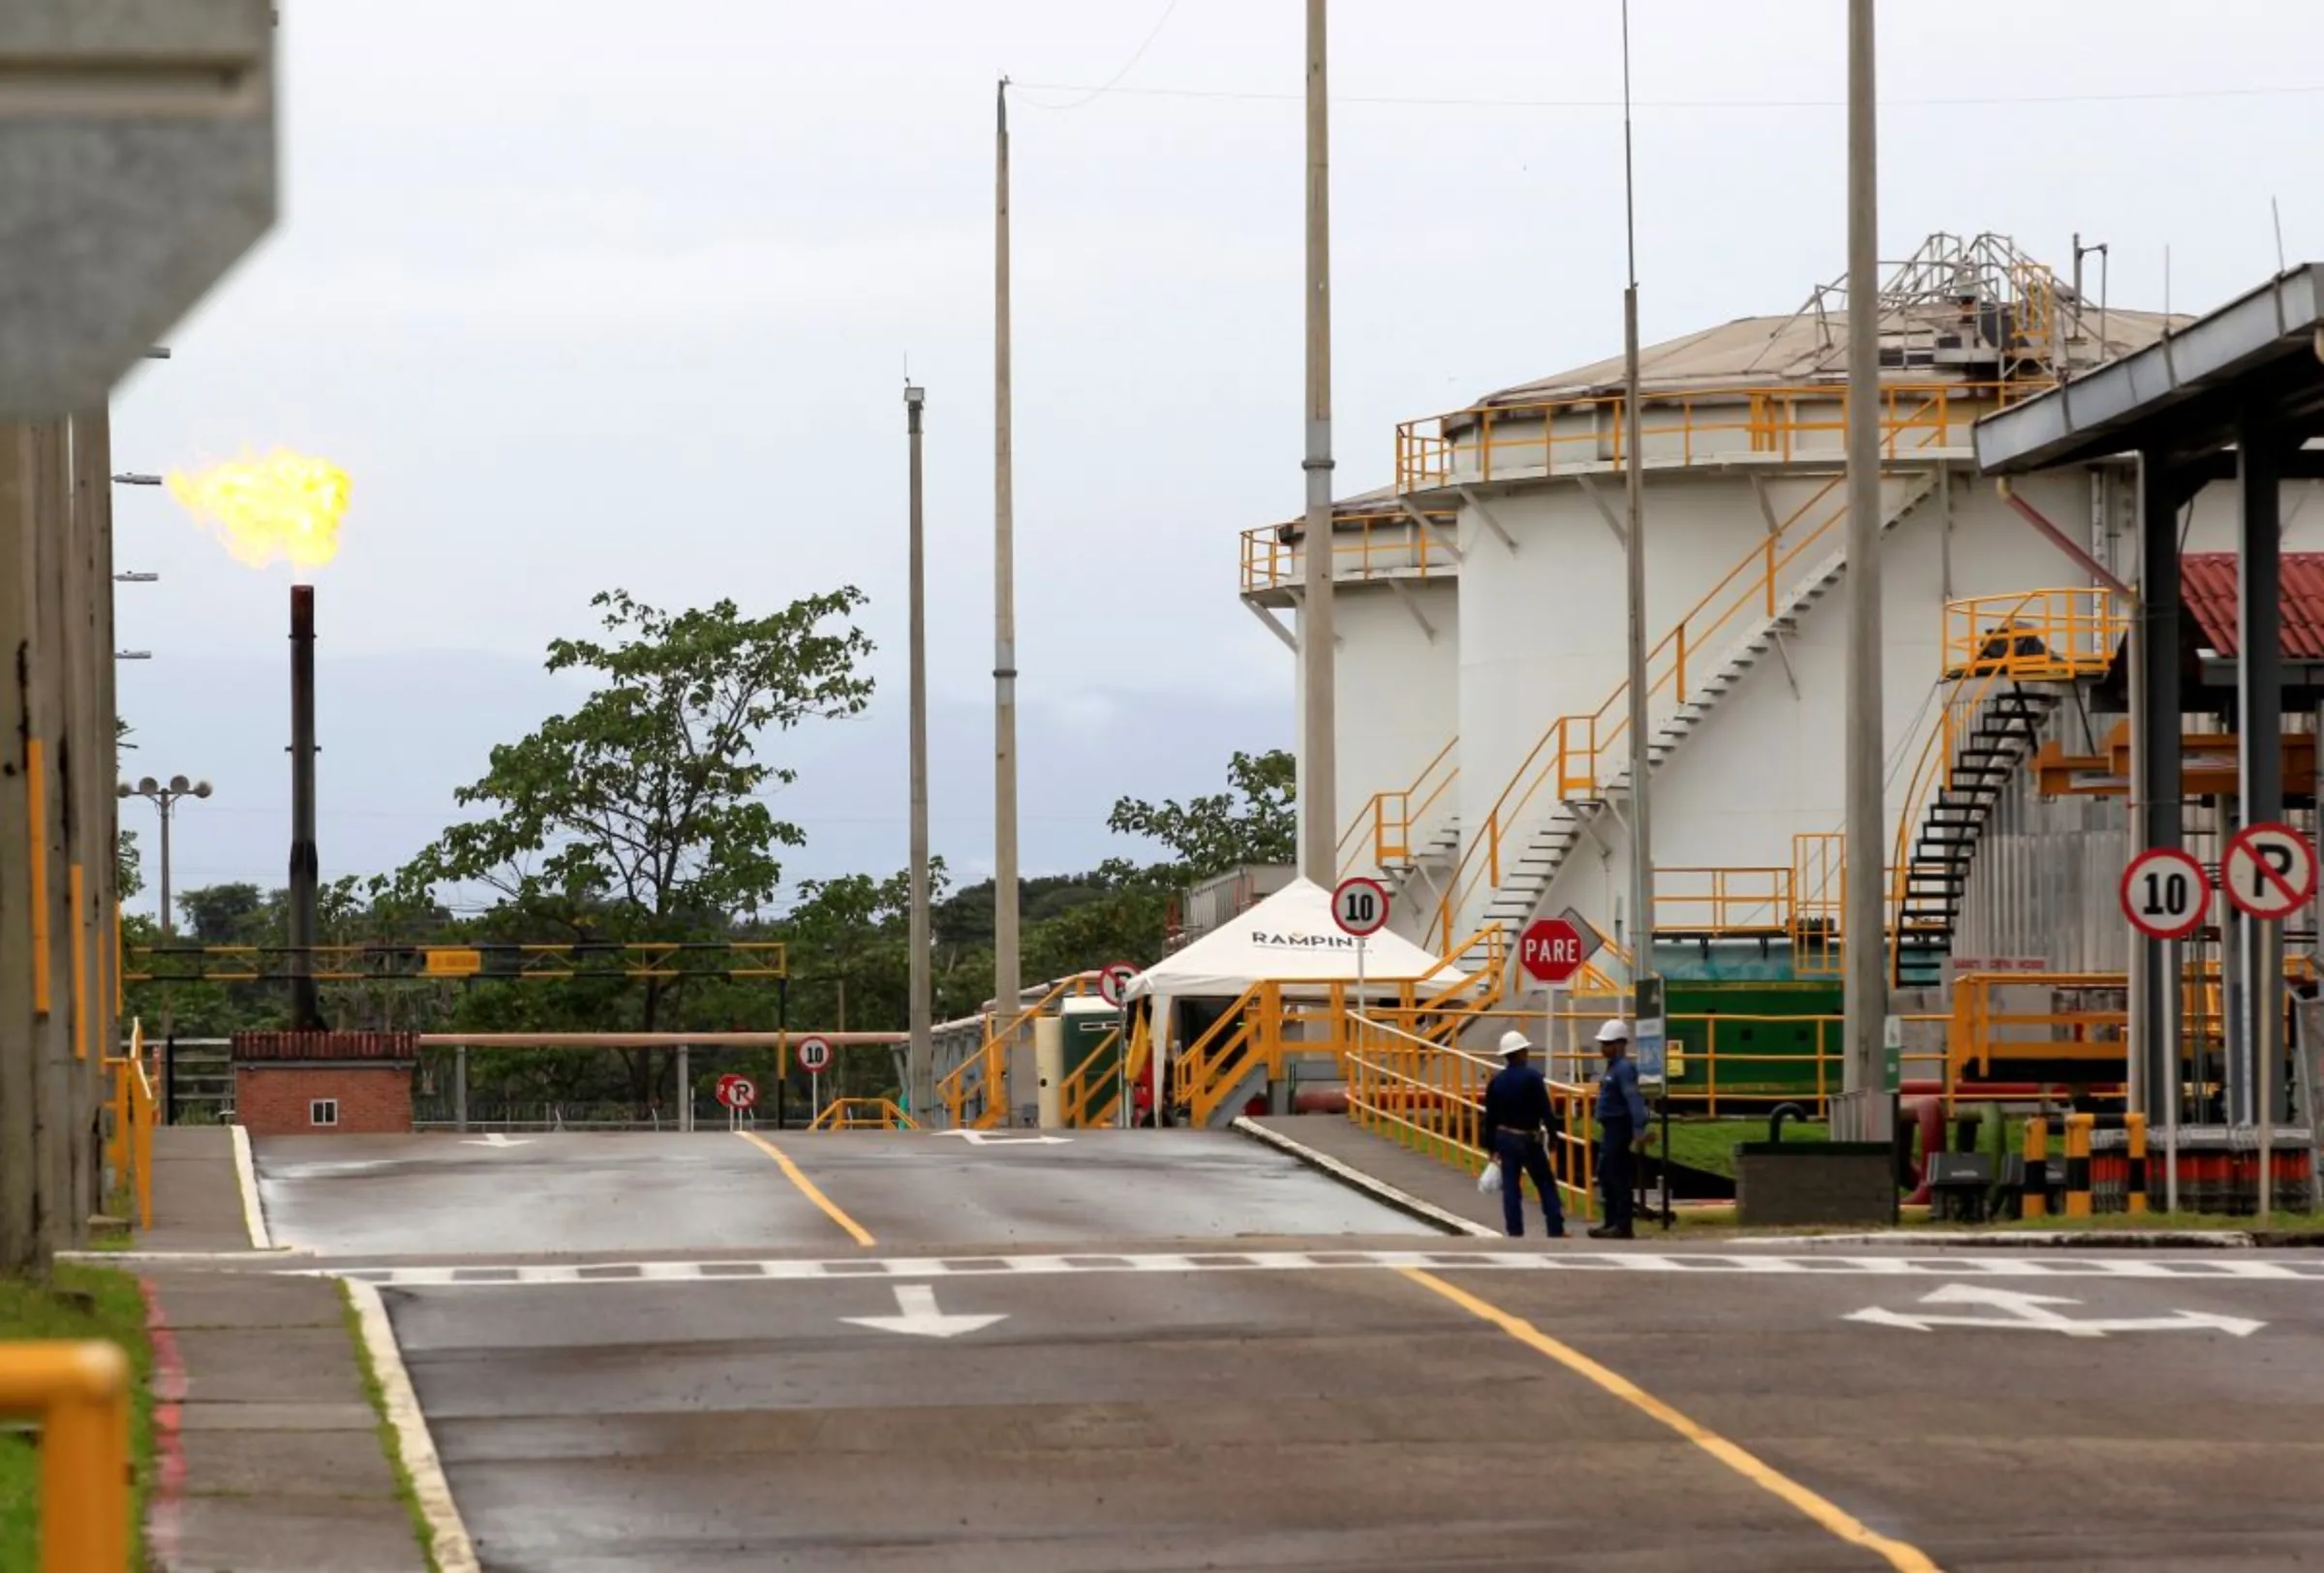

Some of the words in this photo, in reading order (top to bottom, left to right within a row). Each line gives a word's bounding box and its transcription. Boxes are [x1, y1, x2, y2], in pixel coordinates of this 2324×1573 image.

[2143, 873, 2186, 915] 10
[1345, 893, 1374, 921] 10
[1525, 939, 1577, 962] PARE
[806, 1047, 824, 1064] 10
